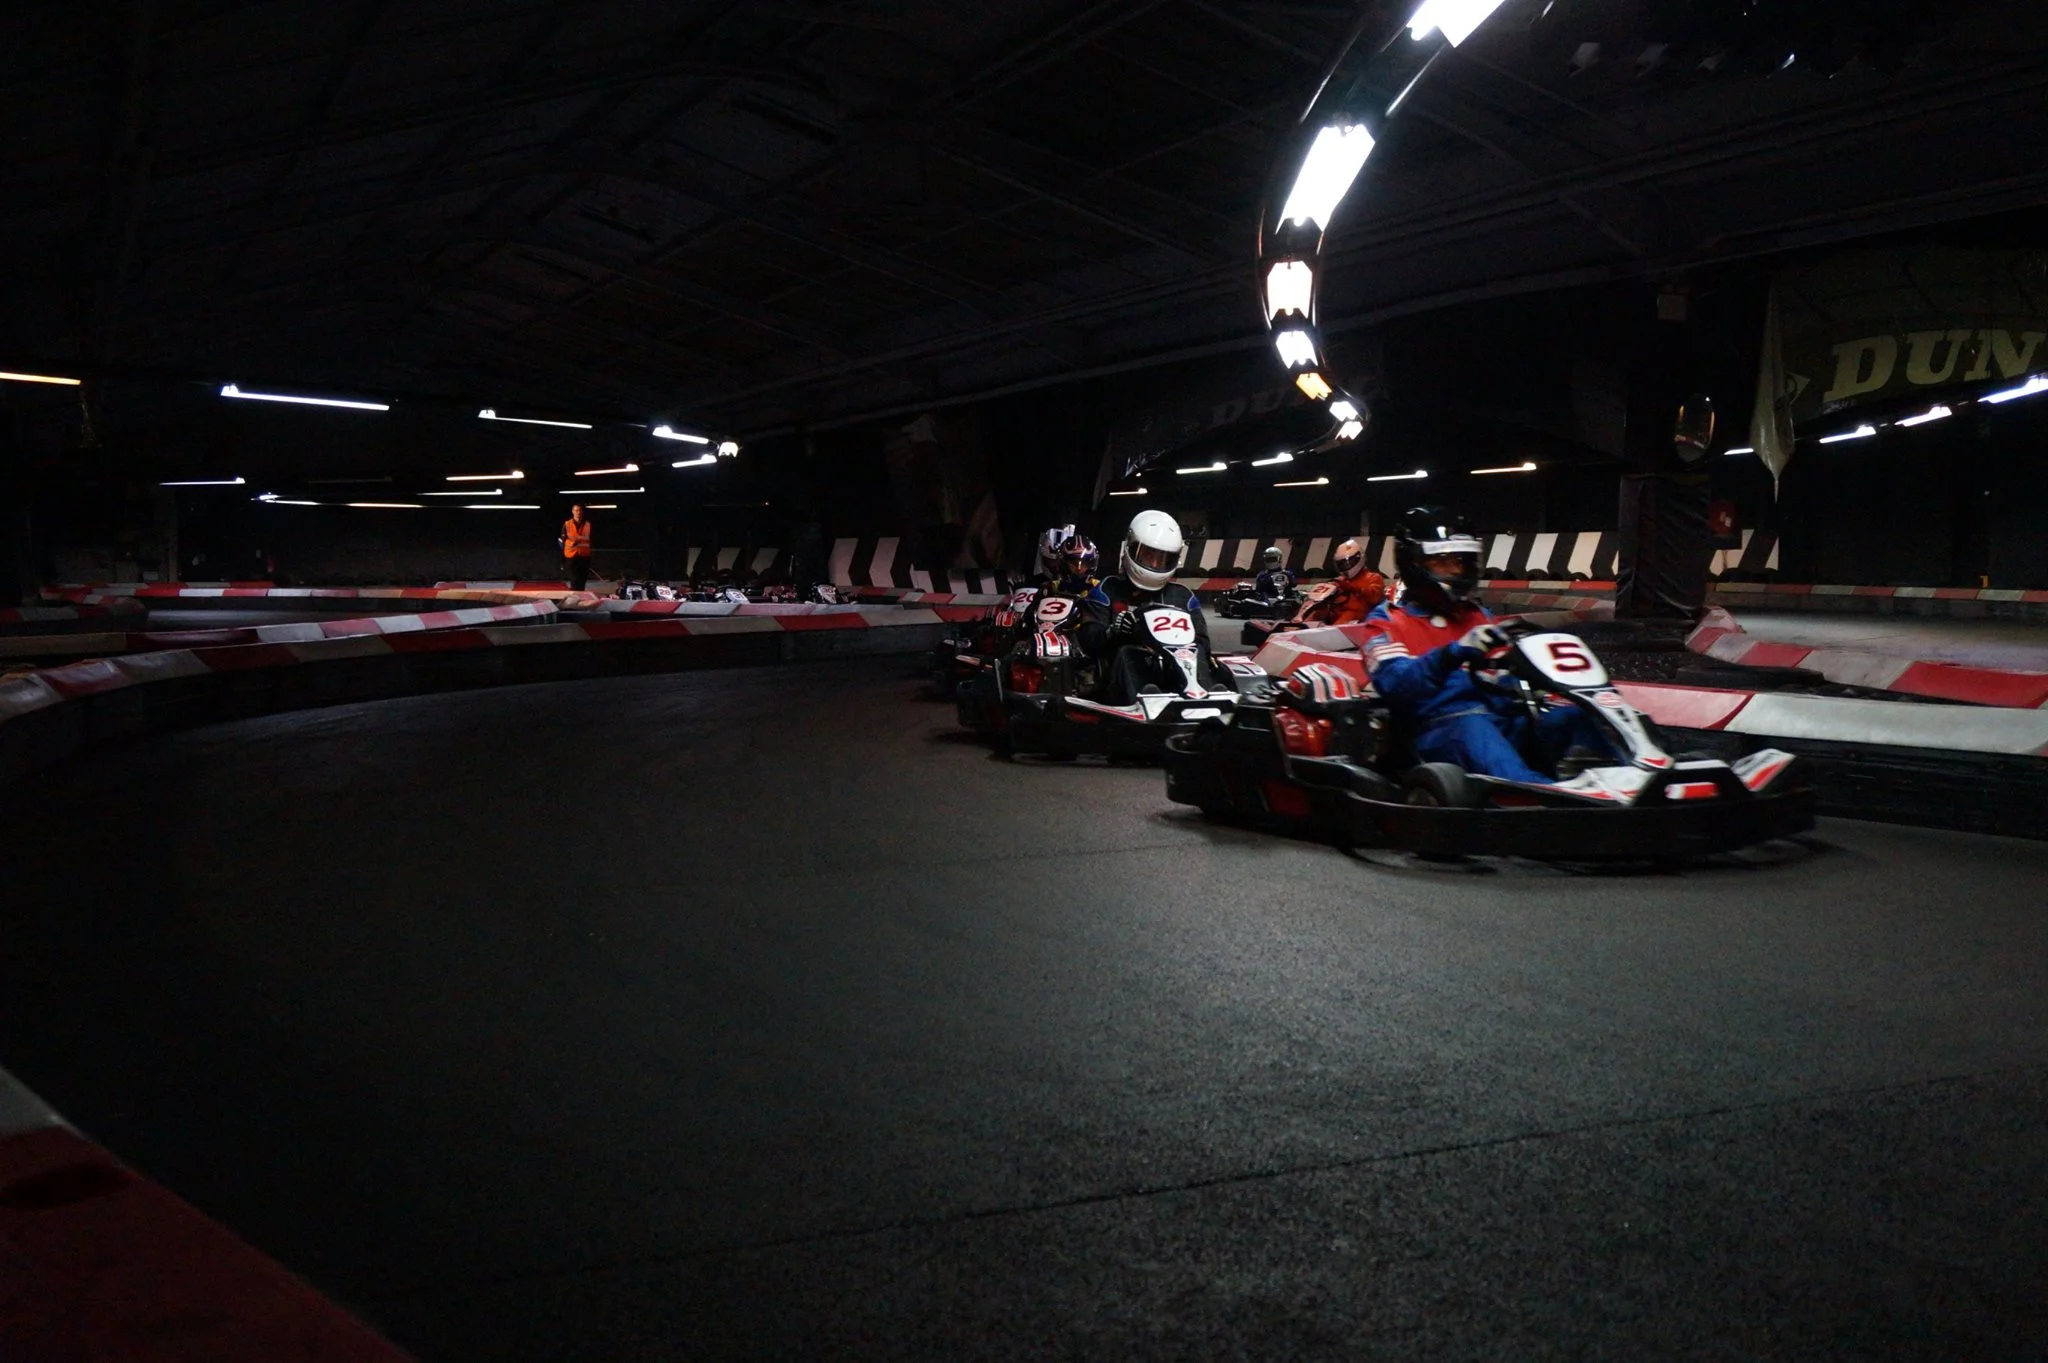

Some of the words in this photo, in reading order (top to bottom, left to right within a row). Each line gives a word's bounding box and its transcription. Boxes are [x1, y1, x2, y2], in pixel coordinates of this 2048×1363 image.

[1823, 328, 2047, 402] DUN
[1041, 602, 1067, 615] 3
[1153, 616, 1190, 632] 24
[1548, 643, 1591, 671] 5
